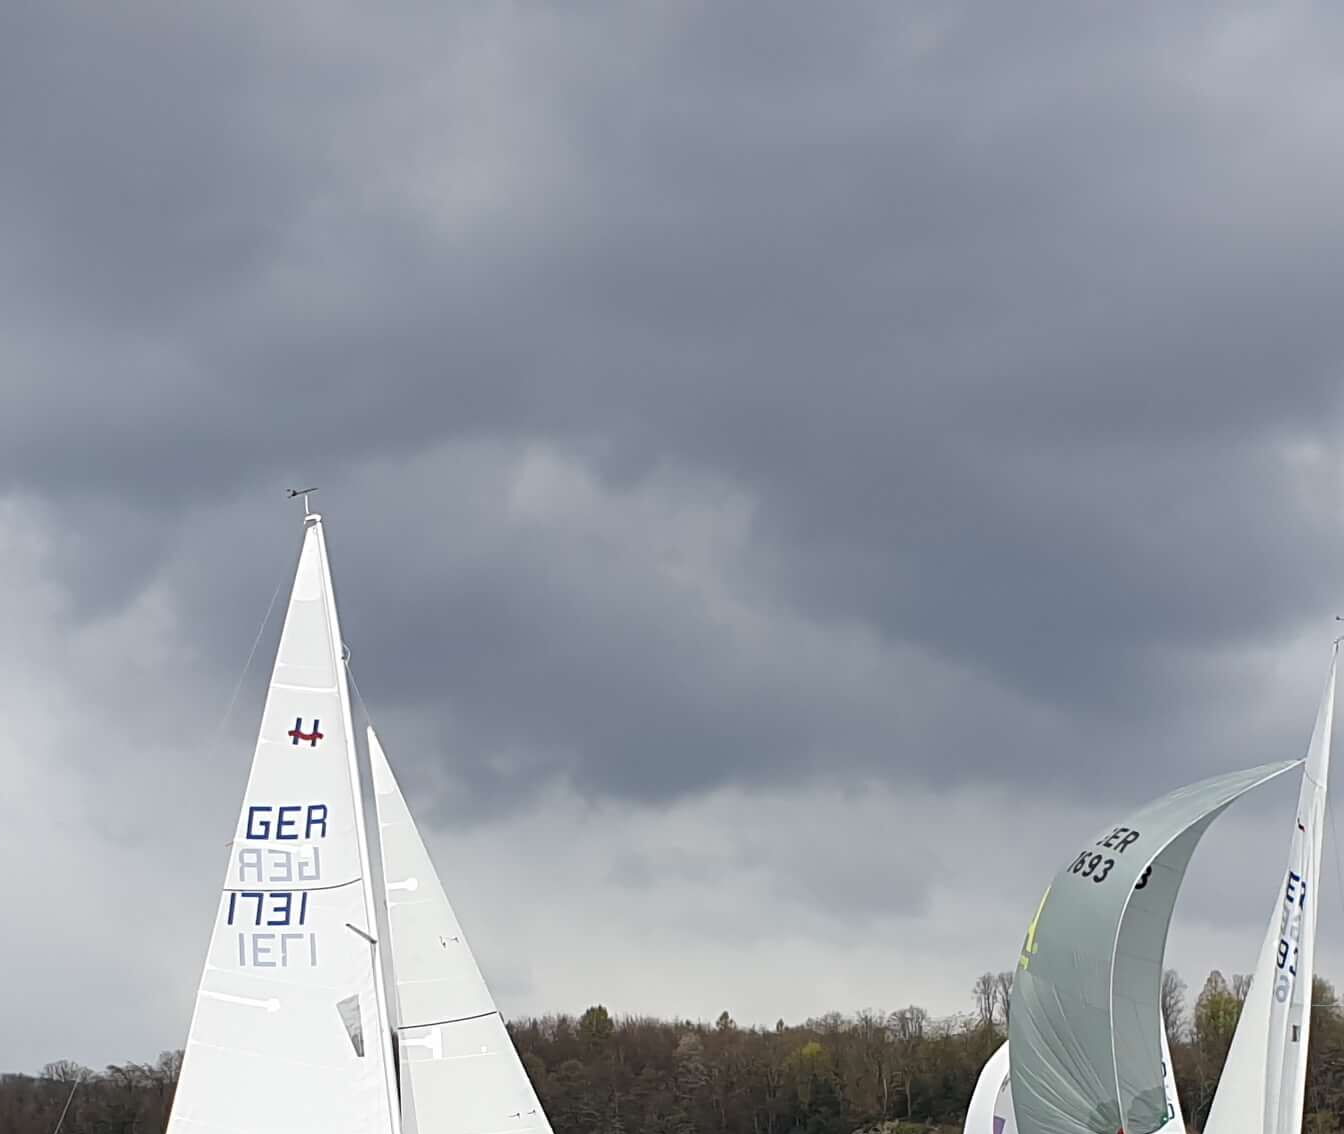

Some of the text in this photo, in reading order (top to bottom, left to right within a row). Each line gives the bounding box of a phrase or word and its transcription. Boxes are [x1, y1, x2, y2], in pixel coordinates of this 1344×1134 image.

[246, 804, 328, 840] GER
[1066, 850, 1115, 883] 1693
[227, 891, 308, 926] 1731
